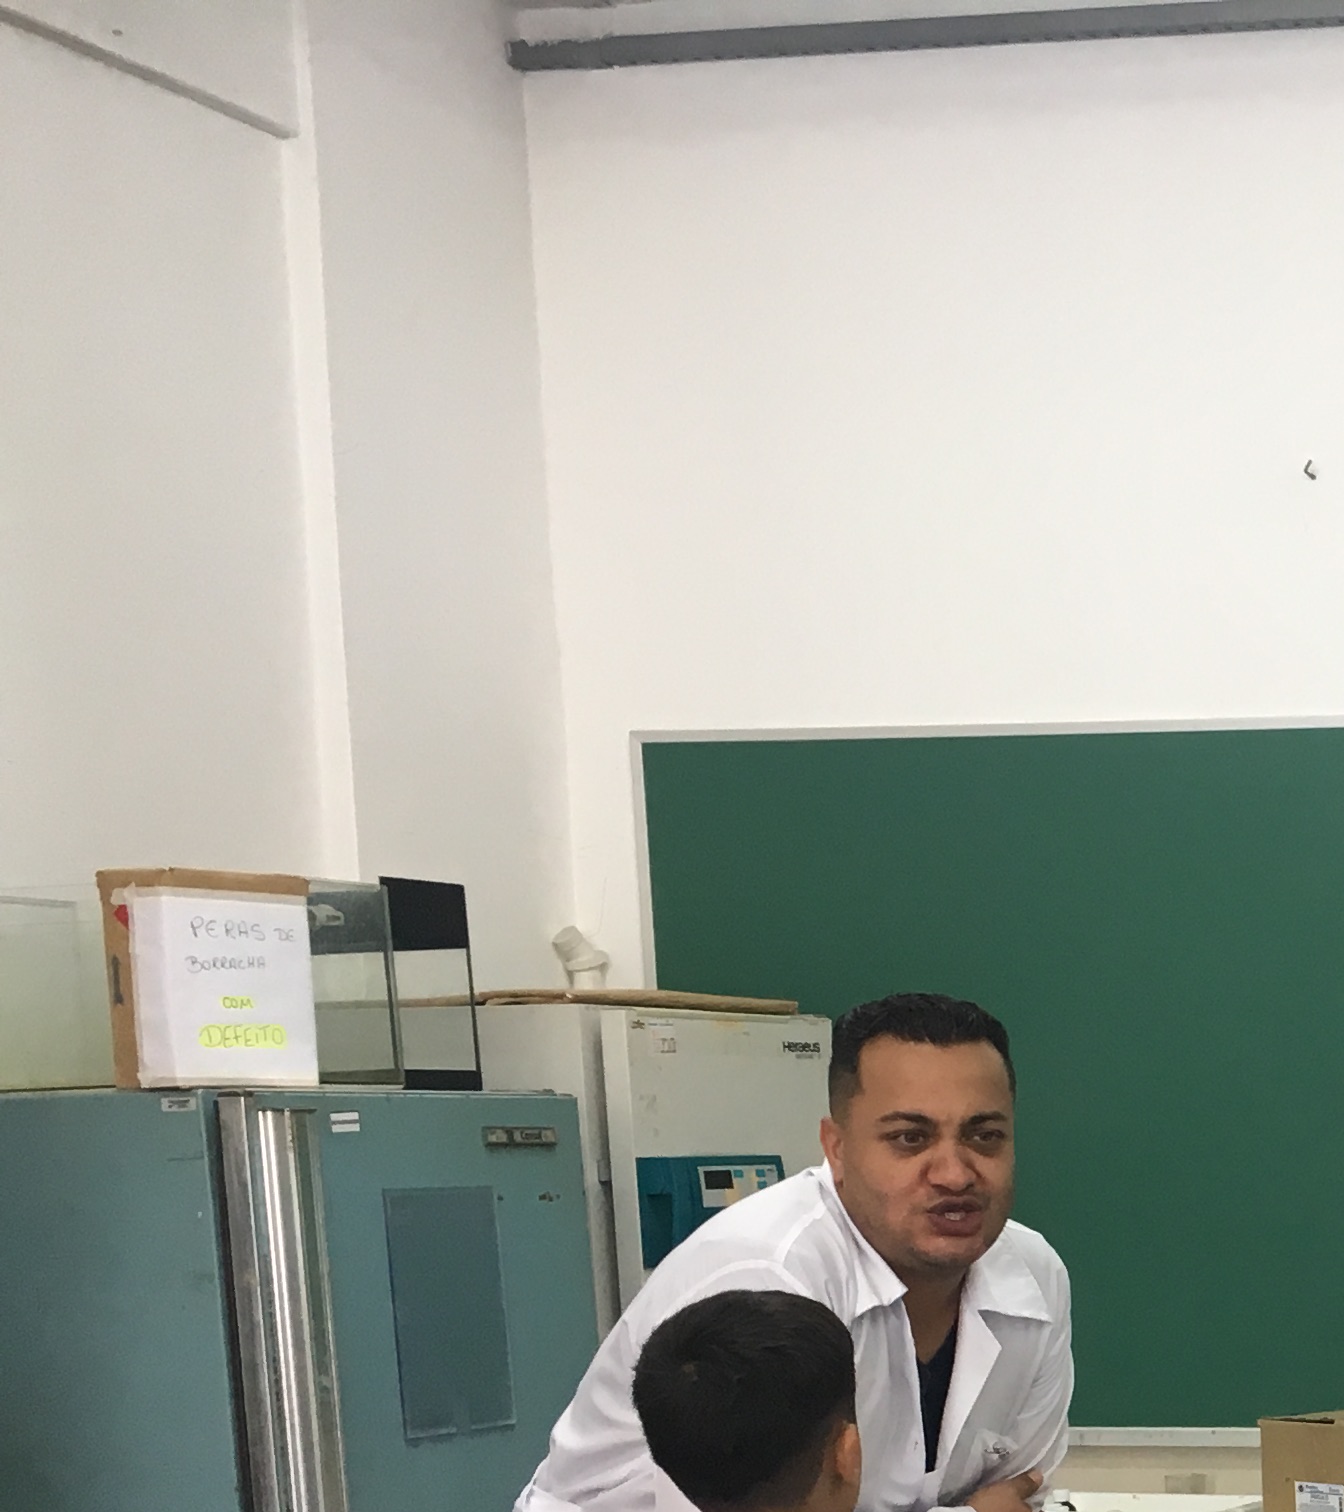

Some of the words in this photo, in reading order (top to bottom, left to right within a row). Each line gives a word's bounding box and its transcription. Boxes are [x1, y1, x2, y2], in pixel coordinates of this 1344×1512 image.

[190, 916, 266, 941] PERAS
[274, 927, 297, 942] DE
[184, 955, 266, 974] BORRACHA
[222, 996, 254, 1009] COM
[199, 1024, 285, 1048] DEFEITO
[782, 1041, 821, 1053] Heraeus
